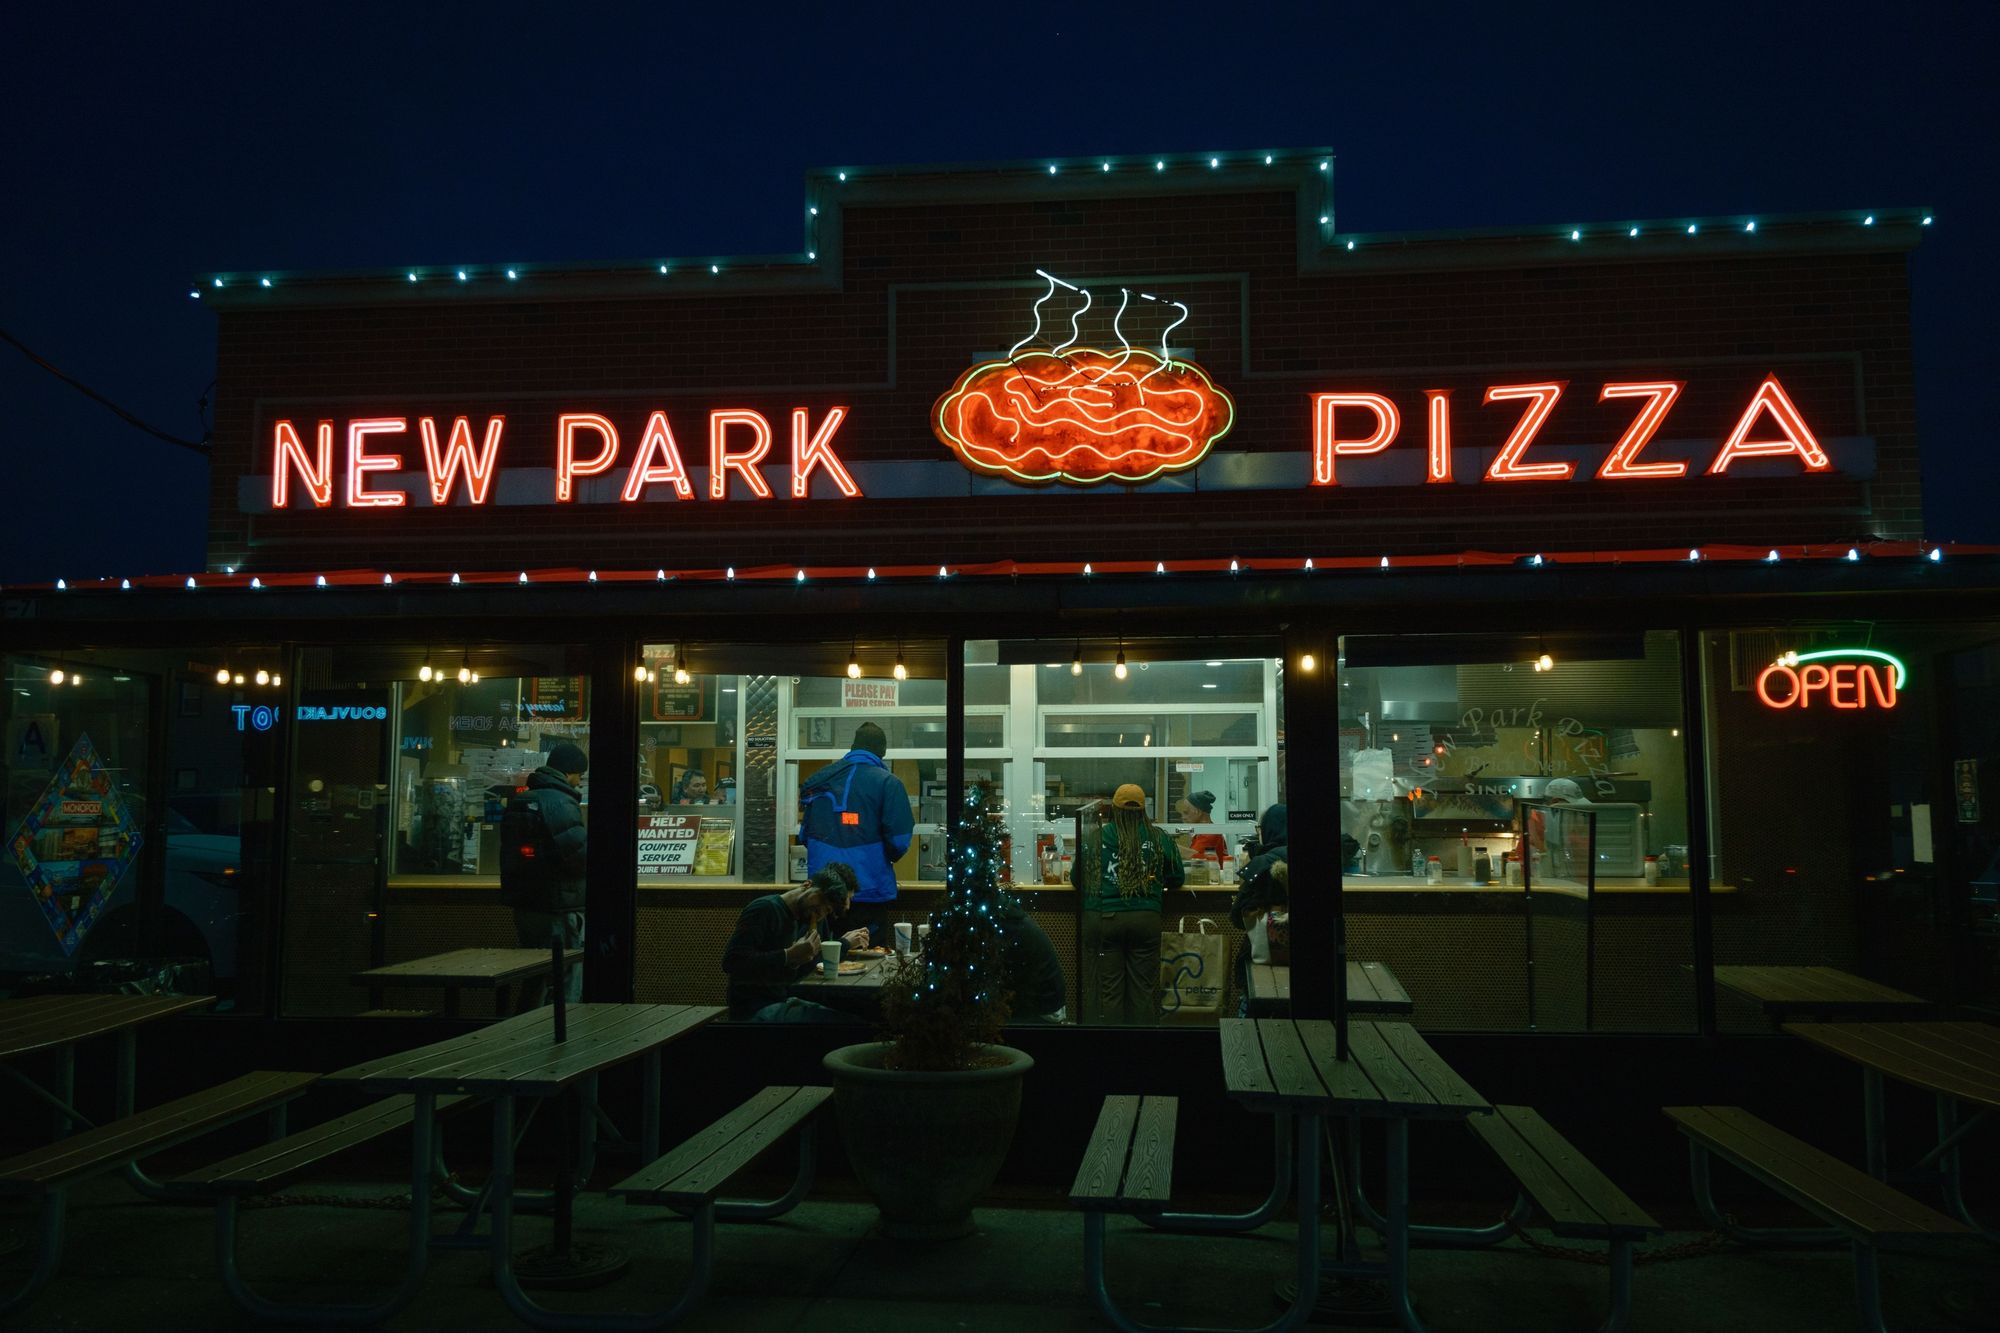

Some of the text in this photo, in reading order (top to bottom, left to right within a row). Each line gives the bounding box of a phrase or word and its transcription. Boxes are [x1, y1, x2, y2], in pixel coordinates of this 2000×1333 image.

[272, 371, 1833, 508] NEW PARK PIZZA
[845, 683, 896, 699] PLEASE PAY
[1757, 664, 1897, 709] OPEN
[1462, 698, 1548, 736] Park
[1557, 718, 1616, 797] Pizza
[1465, 782, 1510, 796] SINC
[63, 802, 100, 814] MONOPOLY
[650, 817, 686, 827] HELP
[638, 828, 695, 838] WANTED
[639, 843, 687, 851] COUNTER
[640, 854, 681, 862] SERVER
[1186, 985, 1217, 996] petco
